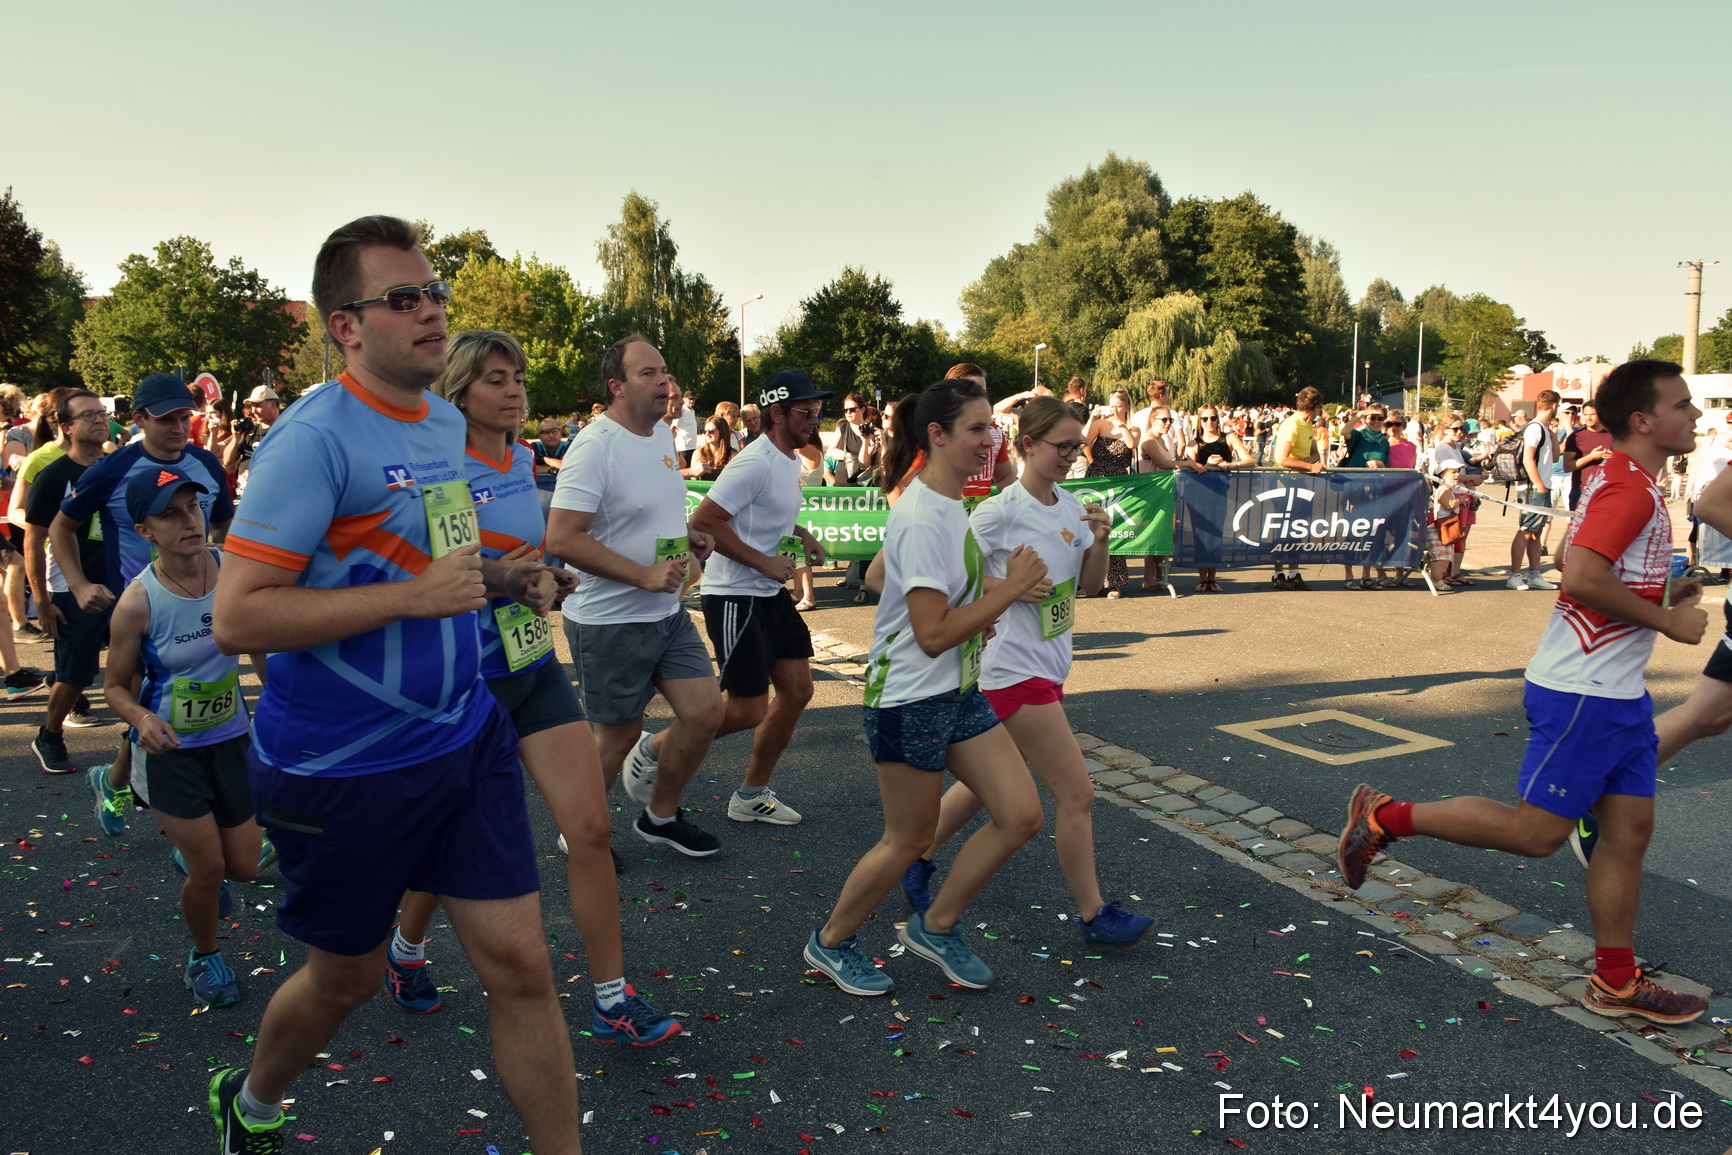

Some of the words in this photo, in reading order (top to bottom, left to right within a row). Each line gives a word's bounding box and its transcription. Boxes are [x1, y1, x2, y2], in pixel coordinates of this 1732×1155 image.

[760, 386, 790, 407] das
[1109, 530, 1137, 539] asse.
[1261, 511, 1386, 539] Fischer
[1270, 541, 1373, 553] AUTOMOBILE
[1051, 599, 1070, 623] 989
[511, 616, 548, 649] 1586
[182, 690, 232, 718] 1768
